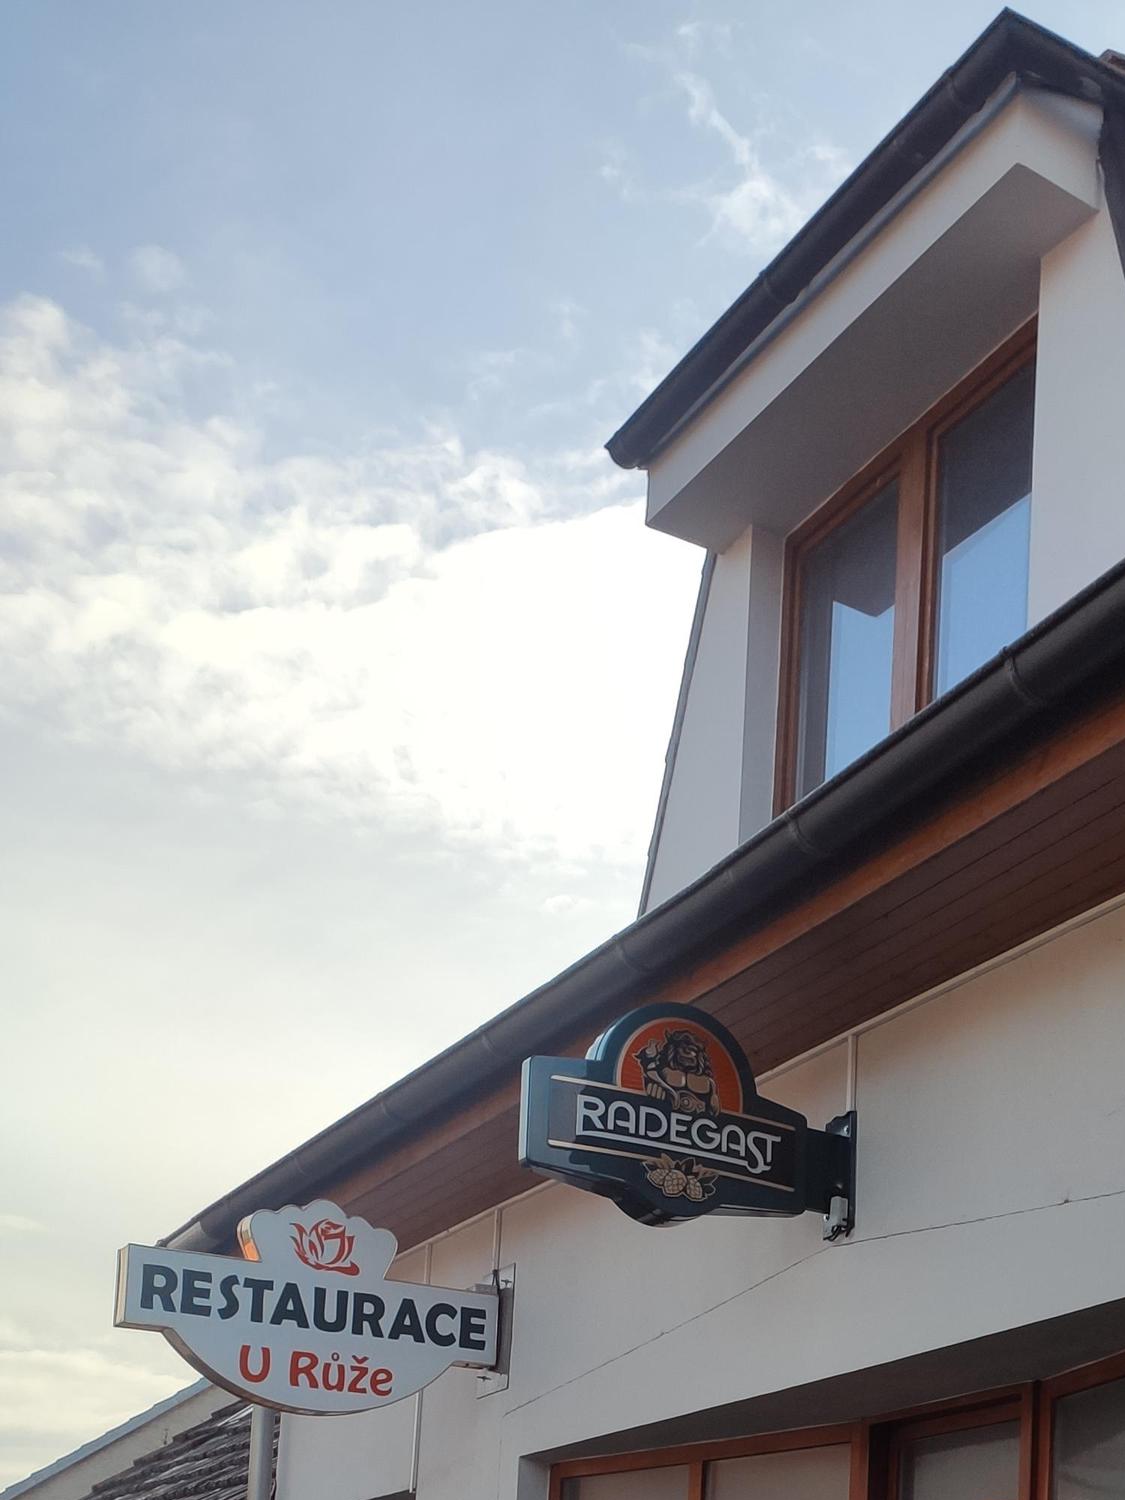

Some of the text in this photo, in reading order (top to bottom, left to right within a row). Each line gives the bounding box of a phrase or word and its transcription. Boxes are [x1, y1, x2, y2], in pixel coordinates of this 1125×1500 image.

[576, 1094, 781, 1174] RADEGAST
[140, 1263, 487, 1351] RESTAURACE
[239, 1344, 393, 1397] U Růže
